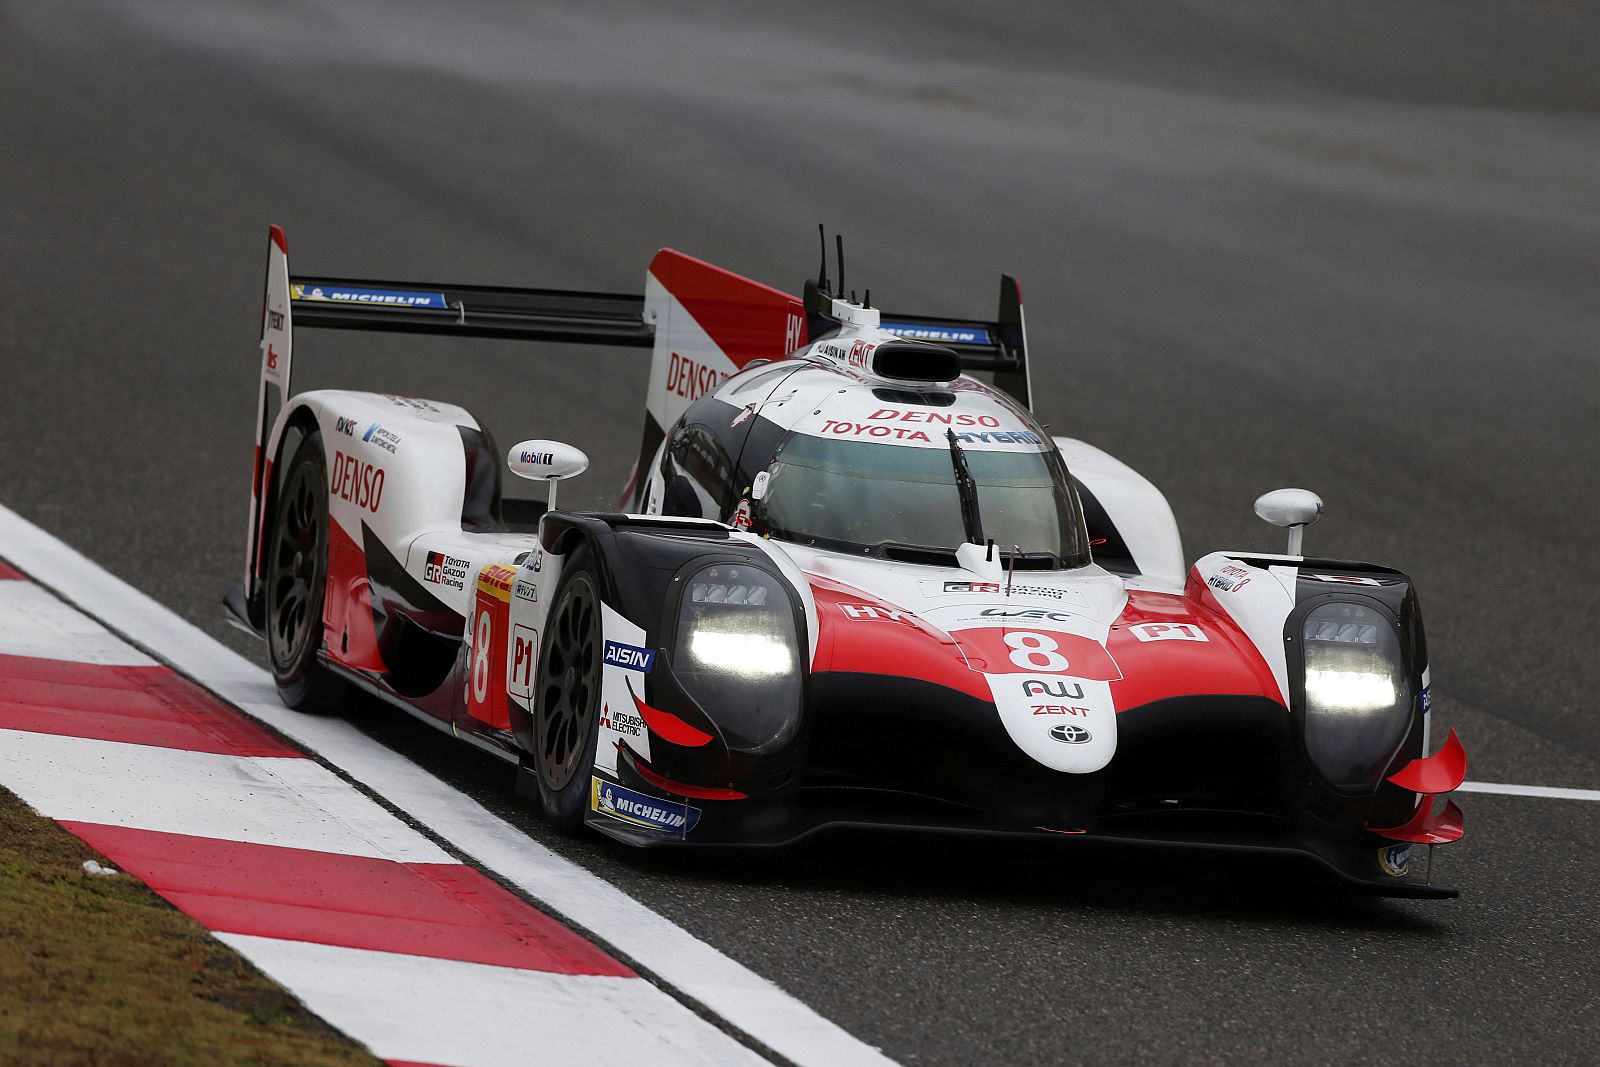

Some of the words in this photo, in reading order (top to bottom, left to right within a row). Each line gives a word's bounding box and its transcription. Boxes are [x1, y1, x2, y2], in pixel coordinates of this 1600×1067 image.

[331, 293, 431, 305] MICHELIN
[785, 313, 802, 355] HY
[848, 339, 876, 371] ZENT
[667, 352, 717, 401] DENSO
[866, 409, 1000, 429] DENSO
[821, 420, 932, 443] TOYOTA
[520, 451, 543, 465] Mobil
[331, 450, 385, 513] DENSO
[443, 566, 466, 579] GAZOO
[445, 556, 471, 569] TOYOTA
[441, 575, 464, 591] Racing
[482, 565, 516, 592] DHL
[1232, 578, 1252, 593] 8
[842, 604, 901, 621] HY
[1140, 625, 1197, 638] P1
[473, 610, 491, 704] 8
[512, 636, 533, 687] P1
[605, 645, 650, 668] AISIN
[1003, 631, 1070, 672] 8
[1030, 705, 1091, 718] ZENT
[611, 721, 641, 737] ELECTRIC
[616, 798, 686, 828] MICHELIN
